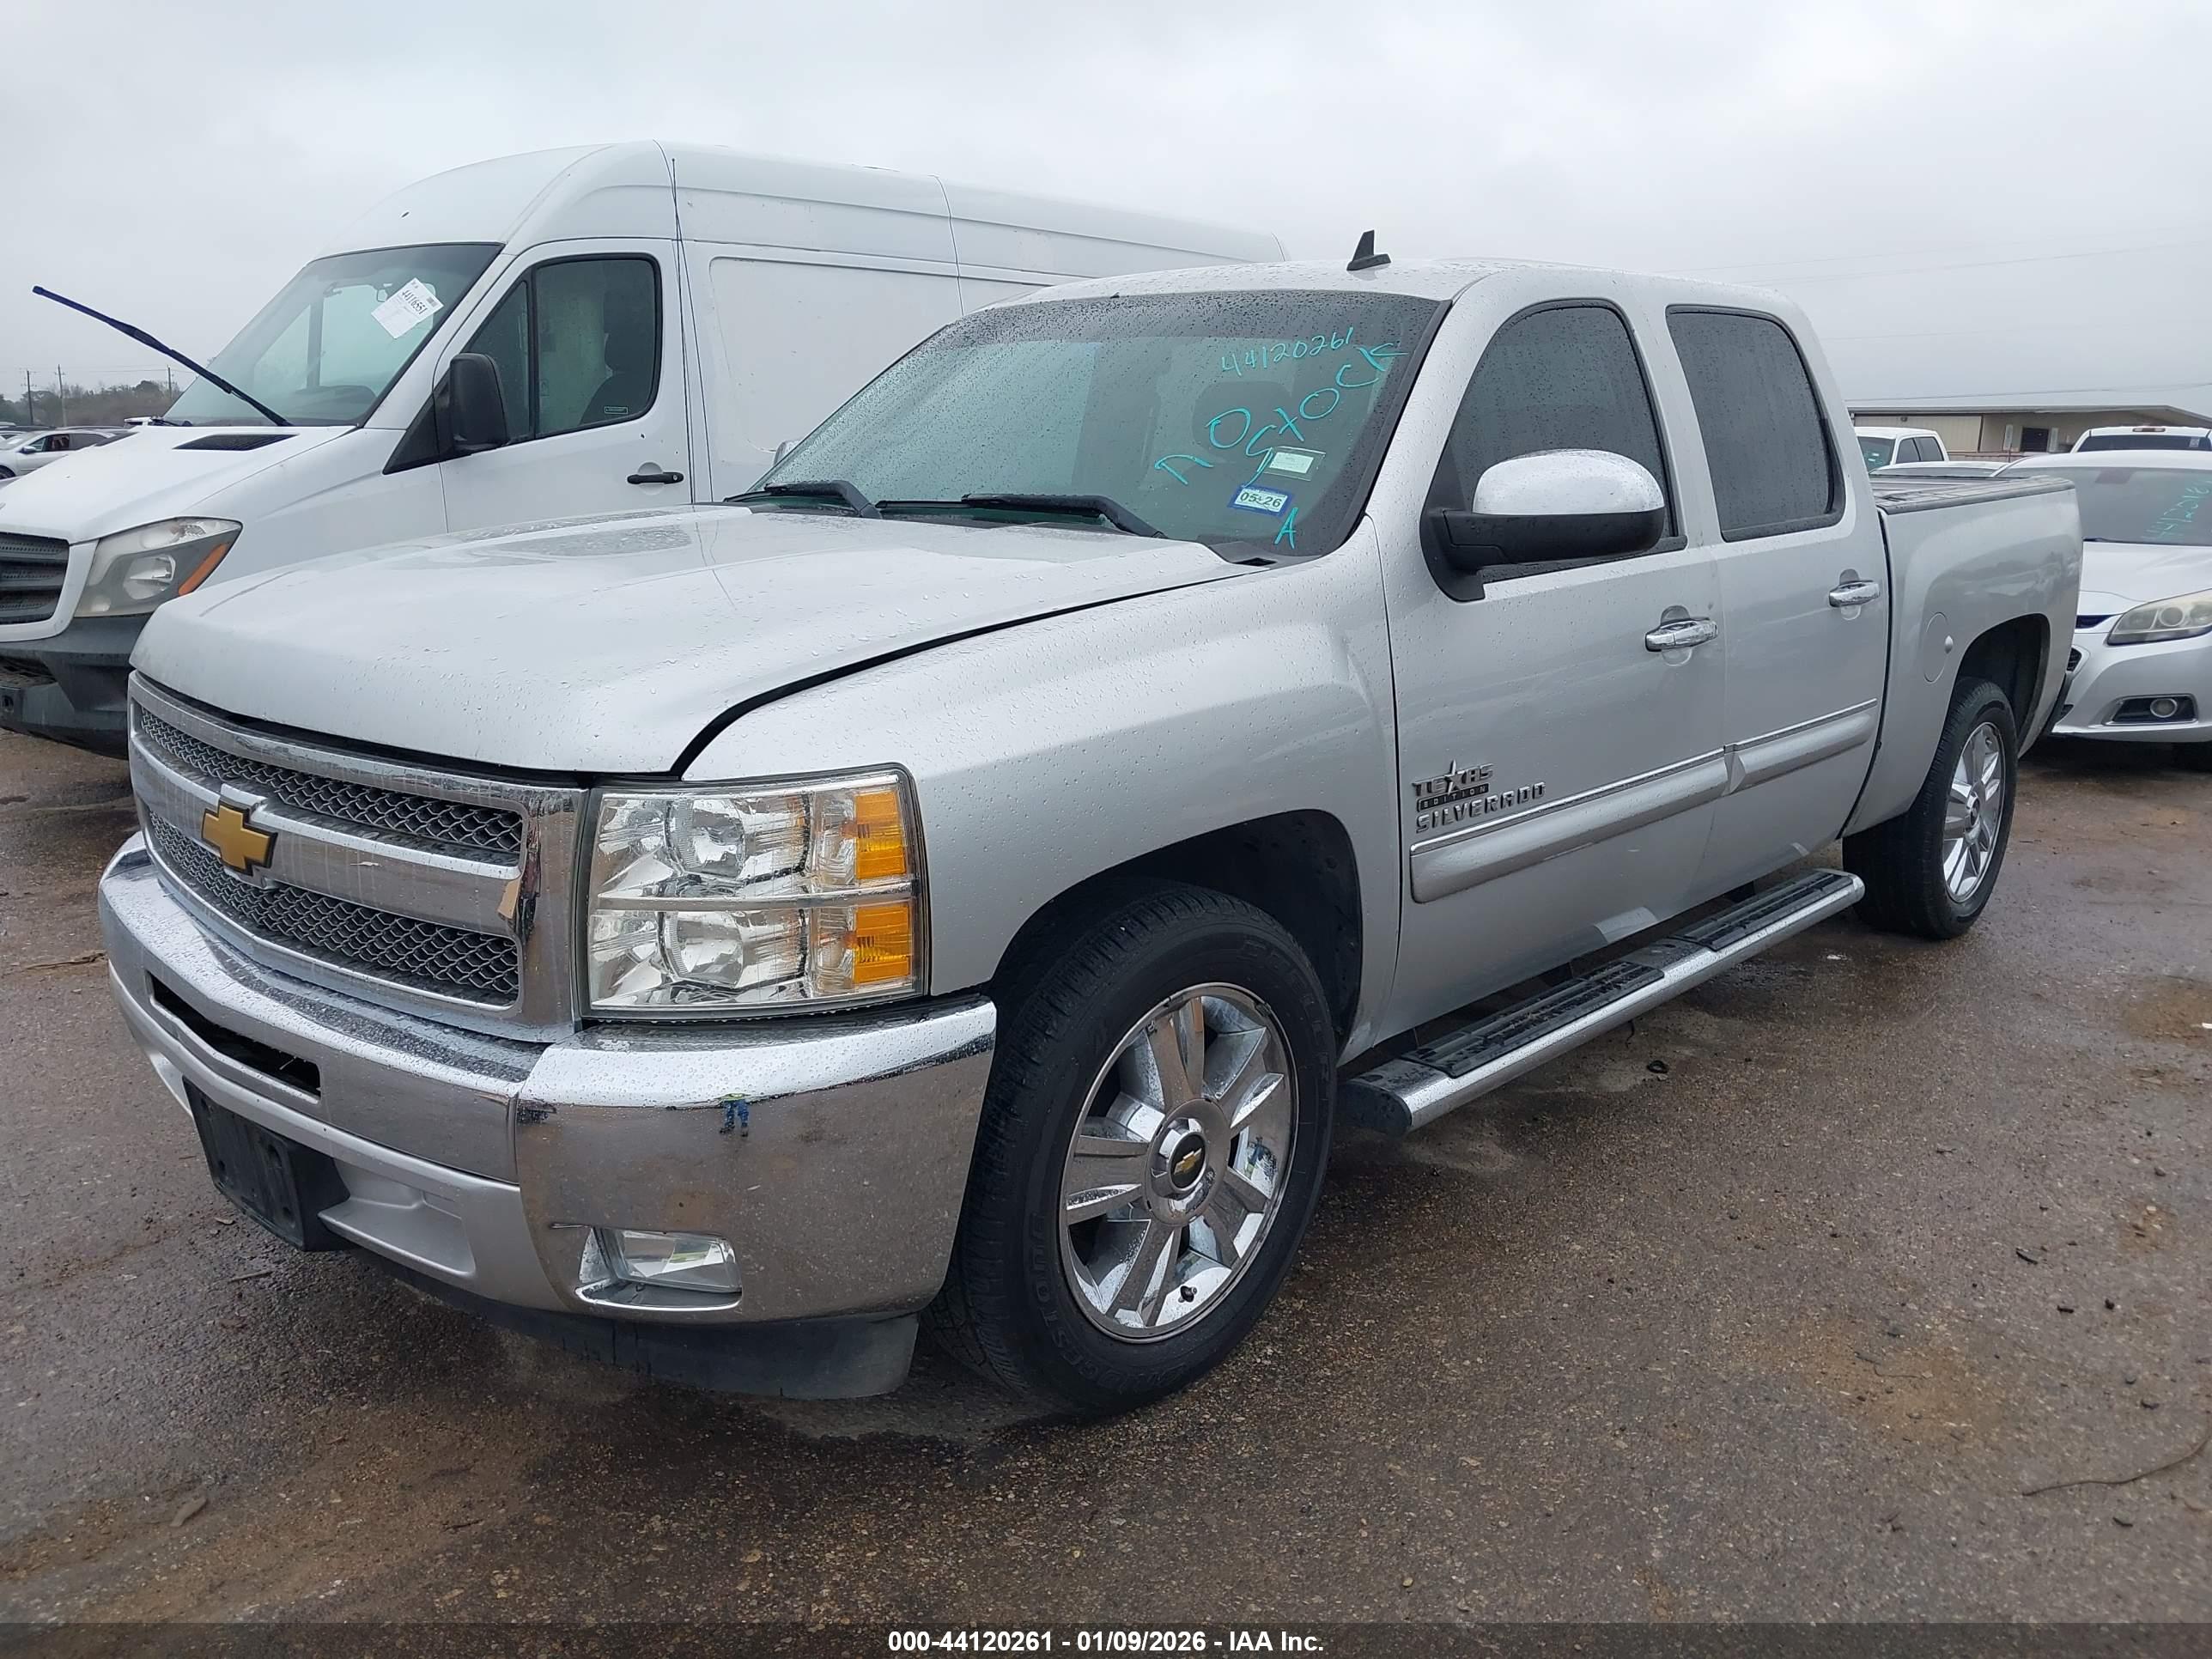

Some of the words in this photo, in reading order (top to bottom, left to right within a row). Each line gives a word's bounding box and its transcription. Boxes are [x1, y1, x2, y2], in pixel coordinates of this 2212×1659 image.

[1221, 326, 1354, 376] 44120261
[1413, 760, 1494, 796] TEXAS
[1422, 785, 1487, 809] EDITION
[1416, 781, 1547, 834] SILVERADO
